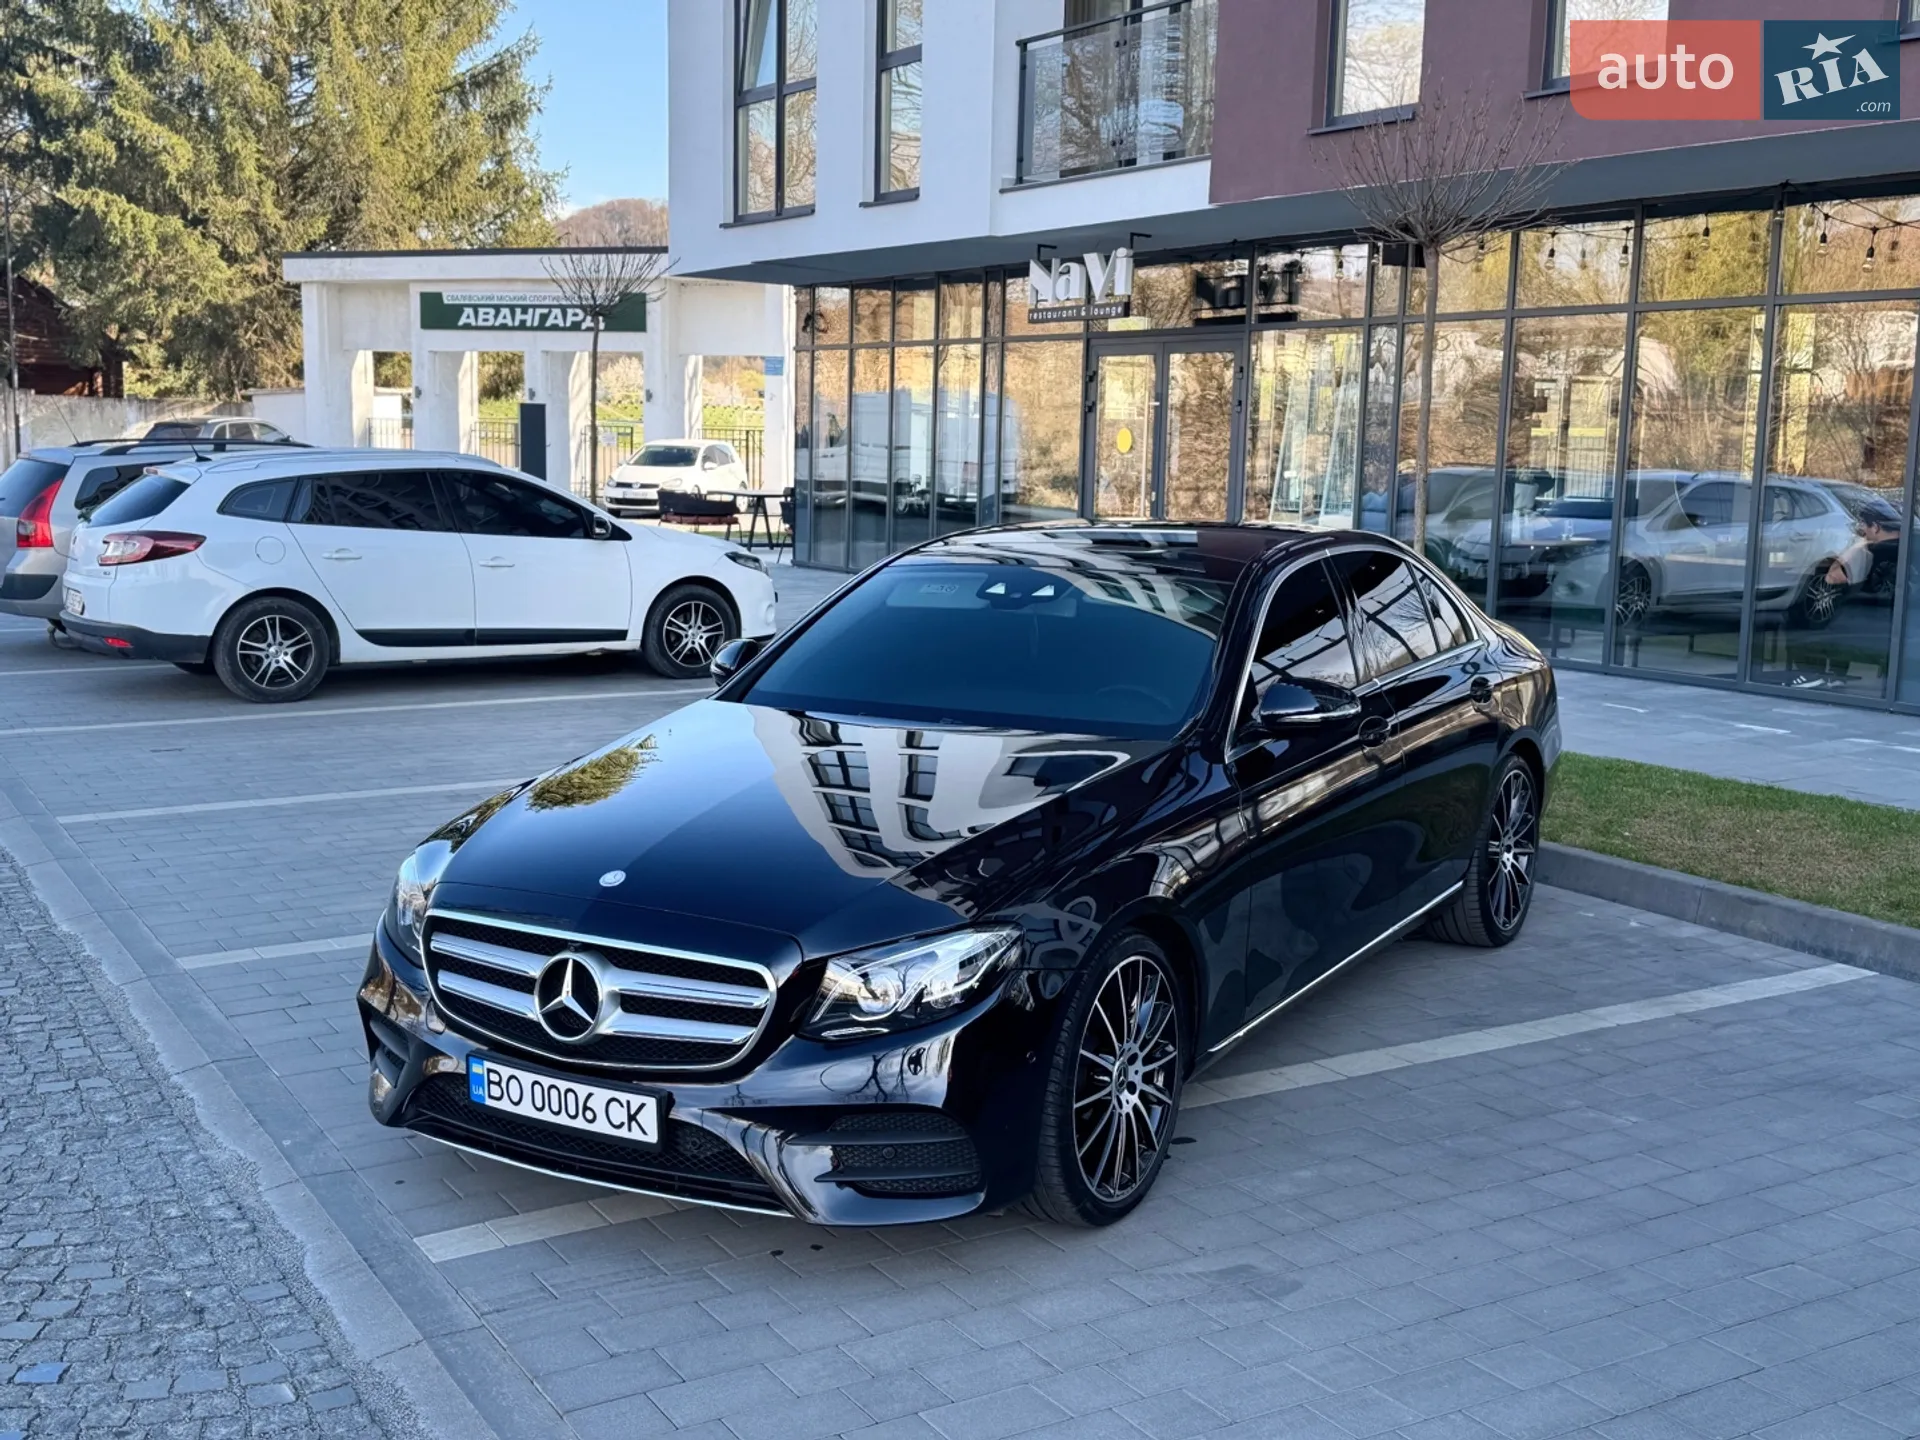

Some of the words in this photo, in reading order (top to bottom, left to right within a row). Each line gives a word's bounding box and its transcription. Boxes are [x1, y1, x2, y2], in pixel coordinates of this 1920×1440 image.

[1029, 247, 1133, 305] NaVi
[1029, 309, 1077, 320] restaurant
[1081, 308, 1086, 316] &
[1090, 305, 1122, 317] lounge
[472, 1087, 484, 1096] UA
[486, 1067, 524, 1107] BO
[530, 1079, 597, 1124] 0006
[604, 1096, 649, 1136] CK
